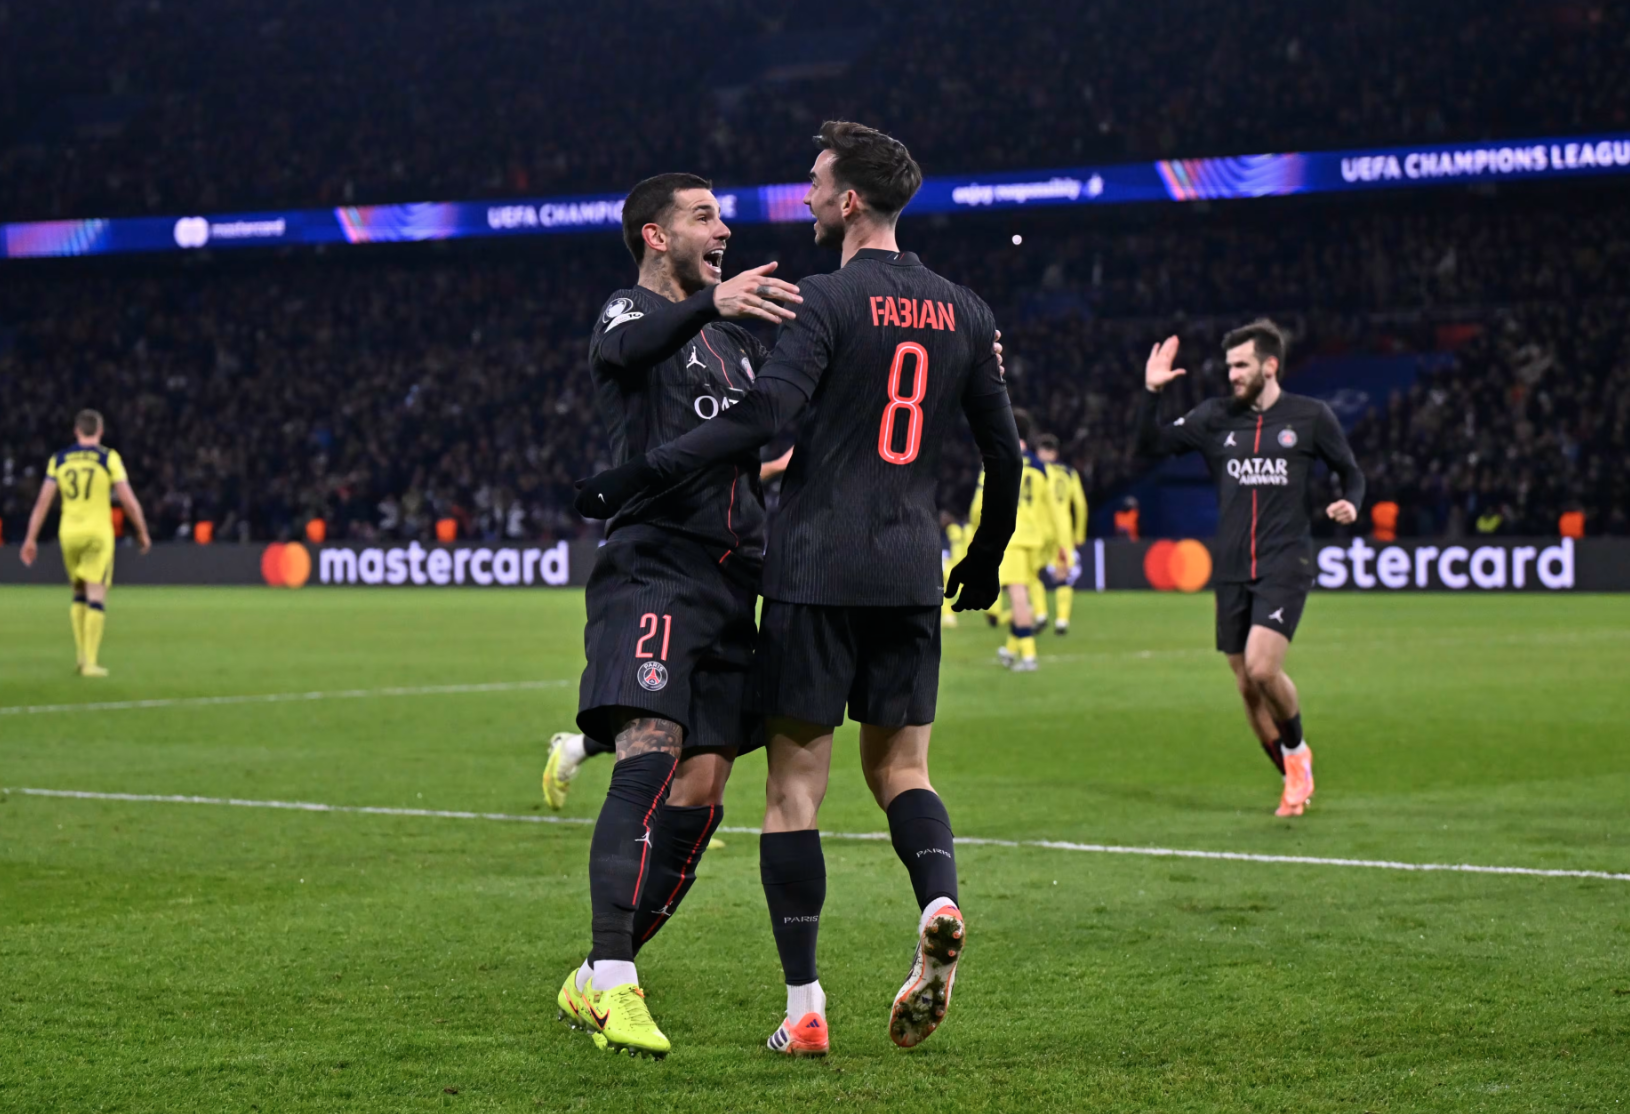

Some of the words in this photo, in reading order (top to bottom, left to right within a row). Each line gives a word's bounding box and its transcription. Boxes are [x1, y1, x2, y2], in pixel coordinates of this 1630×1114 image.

[1341, 154, 1401, 182] UEFA
[1404, 145, 1549, 179] CHAMPIONS
[1550, 139, 1630, 170] LEAGU
[488, 205, 538, 229] UEFA
[539, 200, 625, 227] CHAMPIO
[869, 295, 956, 332] FABIAN
[878, 341, 929, 465] 8
[64, 468, 95, 501] 37
[1227, 457, 1289, 479] QATAR
[319, 540, 570, 586] mastercard
[1316, 536, 1576, 589] stercard
[635, 612, 672, 661] 21
[643, 661, 664, 672] PARIS
[916, 848, 952, 858] PARIS
[783, 914, 819, 924] PARIS
